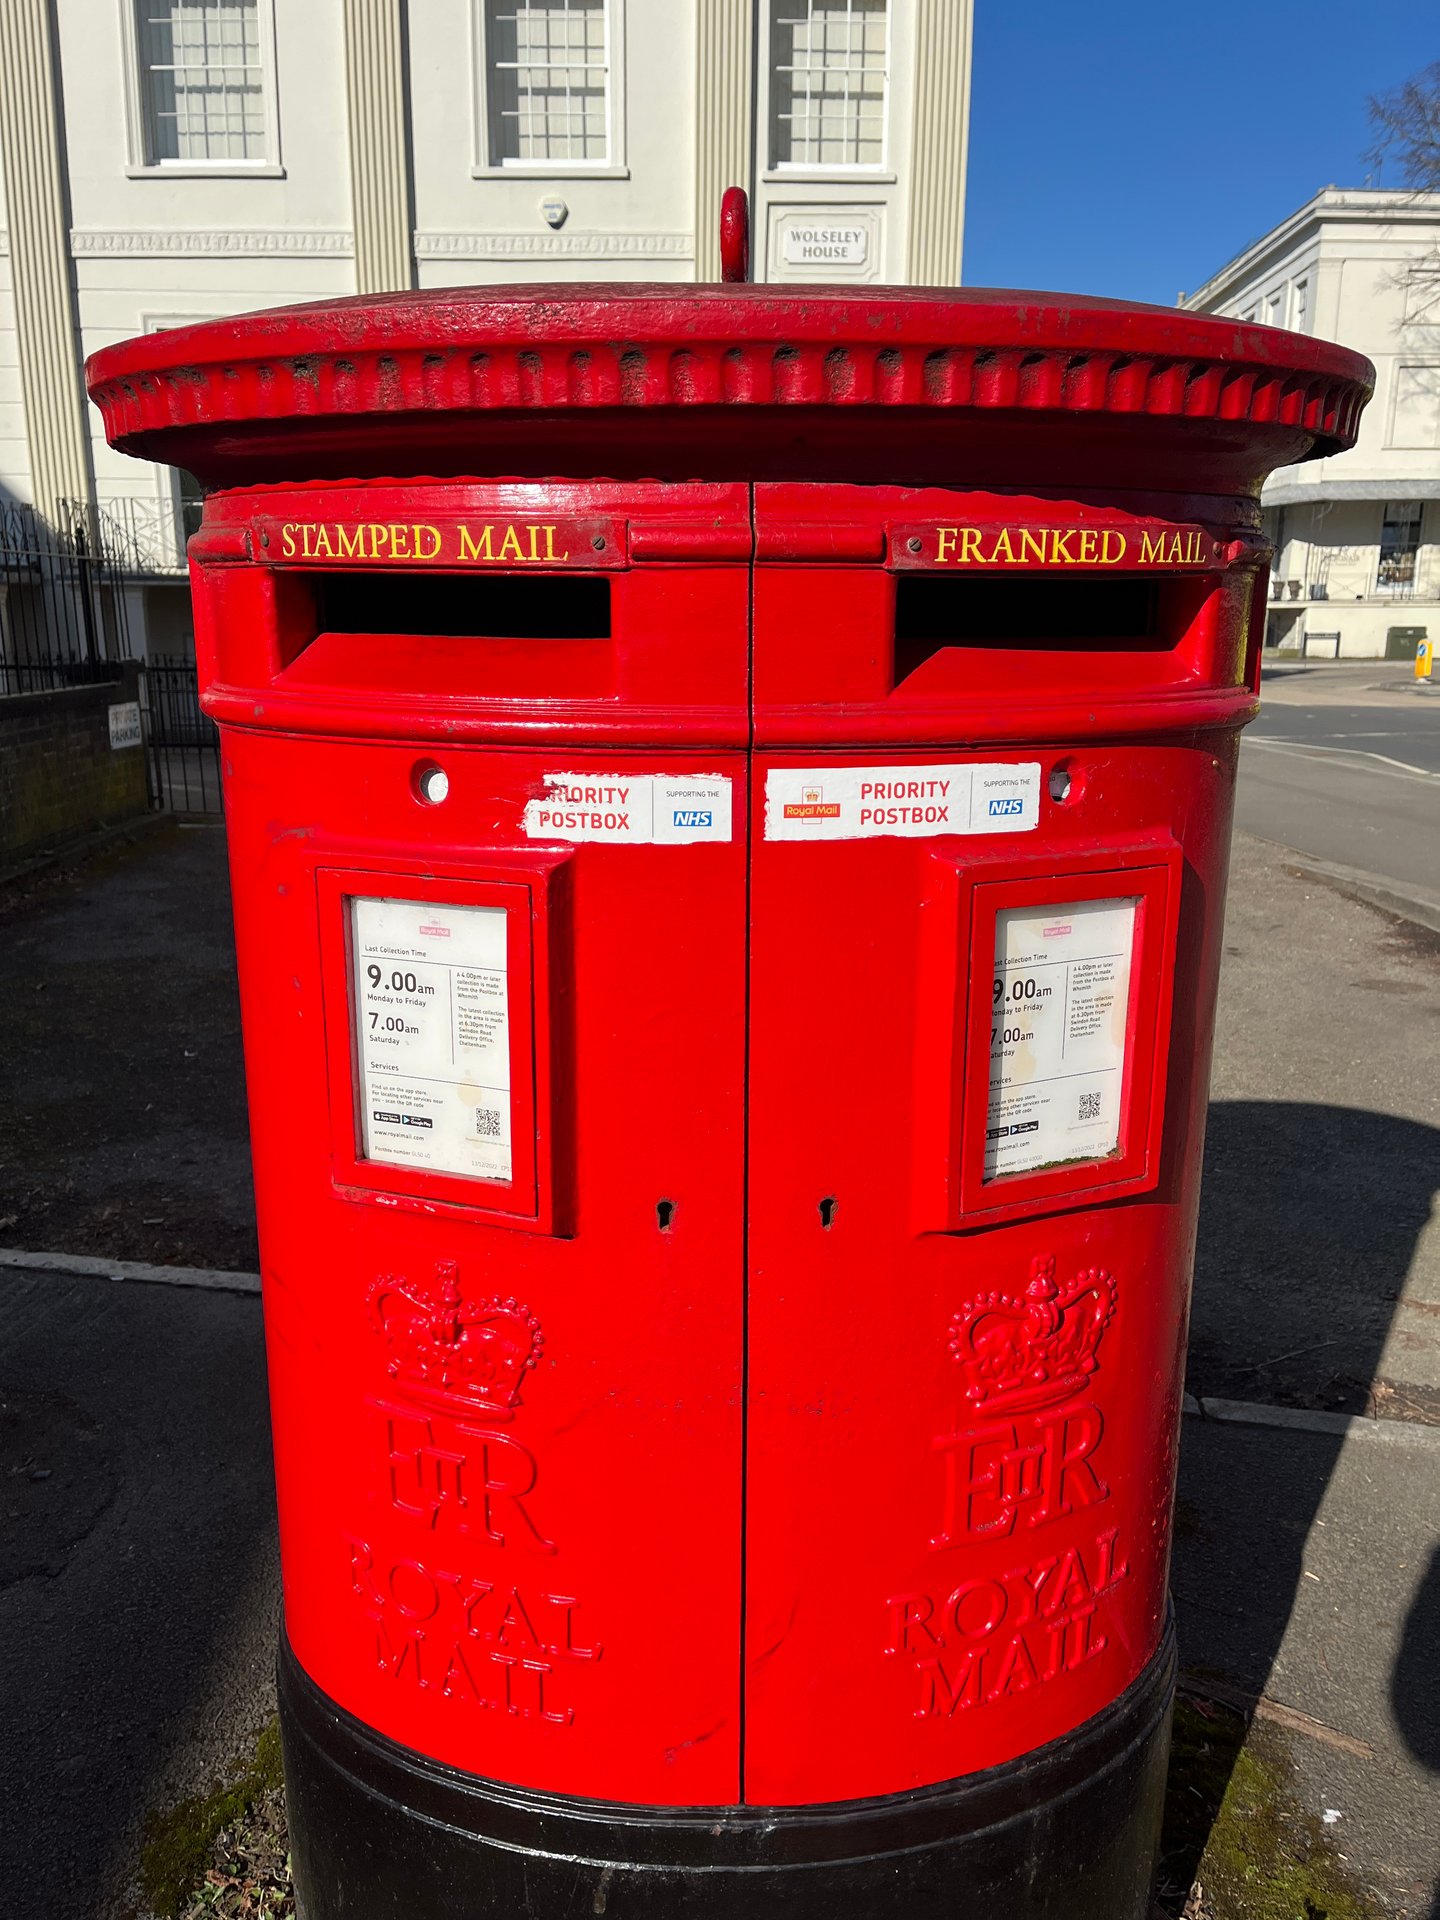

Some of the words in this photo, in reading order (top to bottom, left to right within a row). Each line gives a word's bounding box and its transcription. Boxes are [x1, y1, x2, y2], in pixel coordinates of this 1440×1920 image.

[790, 230, 861, 243] WOLSELEY
[802, 246, 848, 258] HOUSE
[282, 523, 442, 560] STAMPED
[457, 525, 569, 562] MAIL
[934, 527, 1127, 564] FRANKED
[1137, 531, 1207, 564] MAIL
[111, 726, 140, 744] PARKING
[861, 780, 950, 800] PRIORITY
[984, 779, 1019, 788] SUPPORTING
[550, 787, 630, 804] RIORITY
[787, 805, 814, 817] Royal
[816, 805, 838, 815] Mail
[990, 799, 1022, 815] NHS
[539, 812, 630, 829] POSTBOX
[674, 811, 711, 826] NHS
[860, 806, 949, 825] POSTBOX
[379, 946, 410, 956] Collection
[411, 949, 427, 957] Time
[1004, 956, 1032, 965] Collection
[367, 964, 435, 995] 9.00am
[993, 979, 1052, 1004] 9.00am
[368, 994, 394, 1004] Monday
[405, 998, 427, 1008] Friday
[992, 1008, 1013, 1016] onday
[368, 1012, 419, 1034] 7.00am
[369, 1035, 400, 1045] Saturday
[990, 1028, 1034, 1046] 7.00am
[990, 1049, 1015, 1058] aturday
[370, 1061, 399, 1071] Services
[990, 1077, 1012, 1086] ervices
[374, 1130, 425, 1141] www.royalmail.com
[340, 1530, 604, 1662] ROYAL
[884, 1527, 1130, 1659] ROYAL
[366, 1608, 574, 1726] MAIL
[912, 1602, 1109, 1720] MAIL
